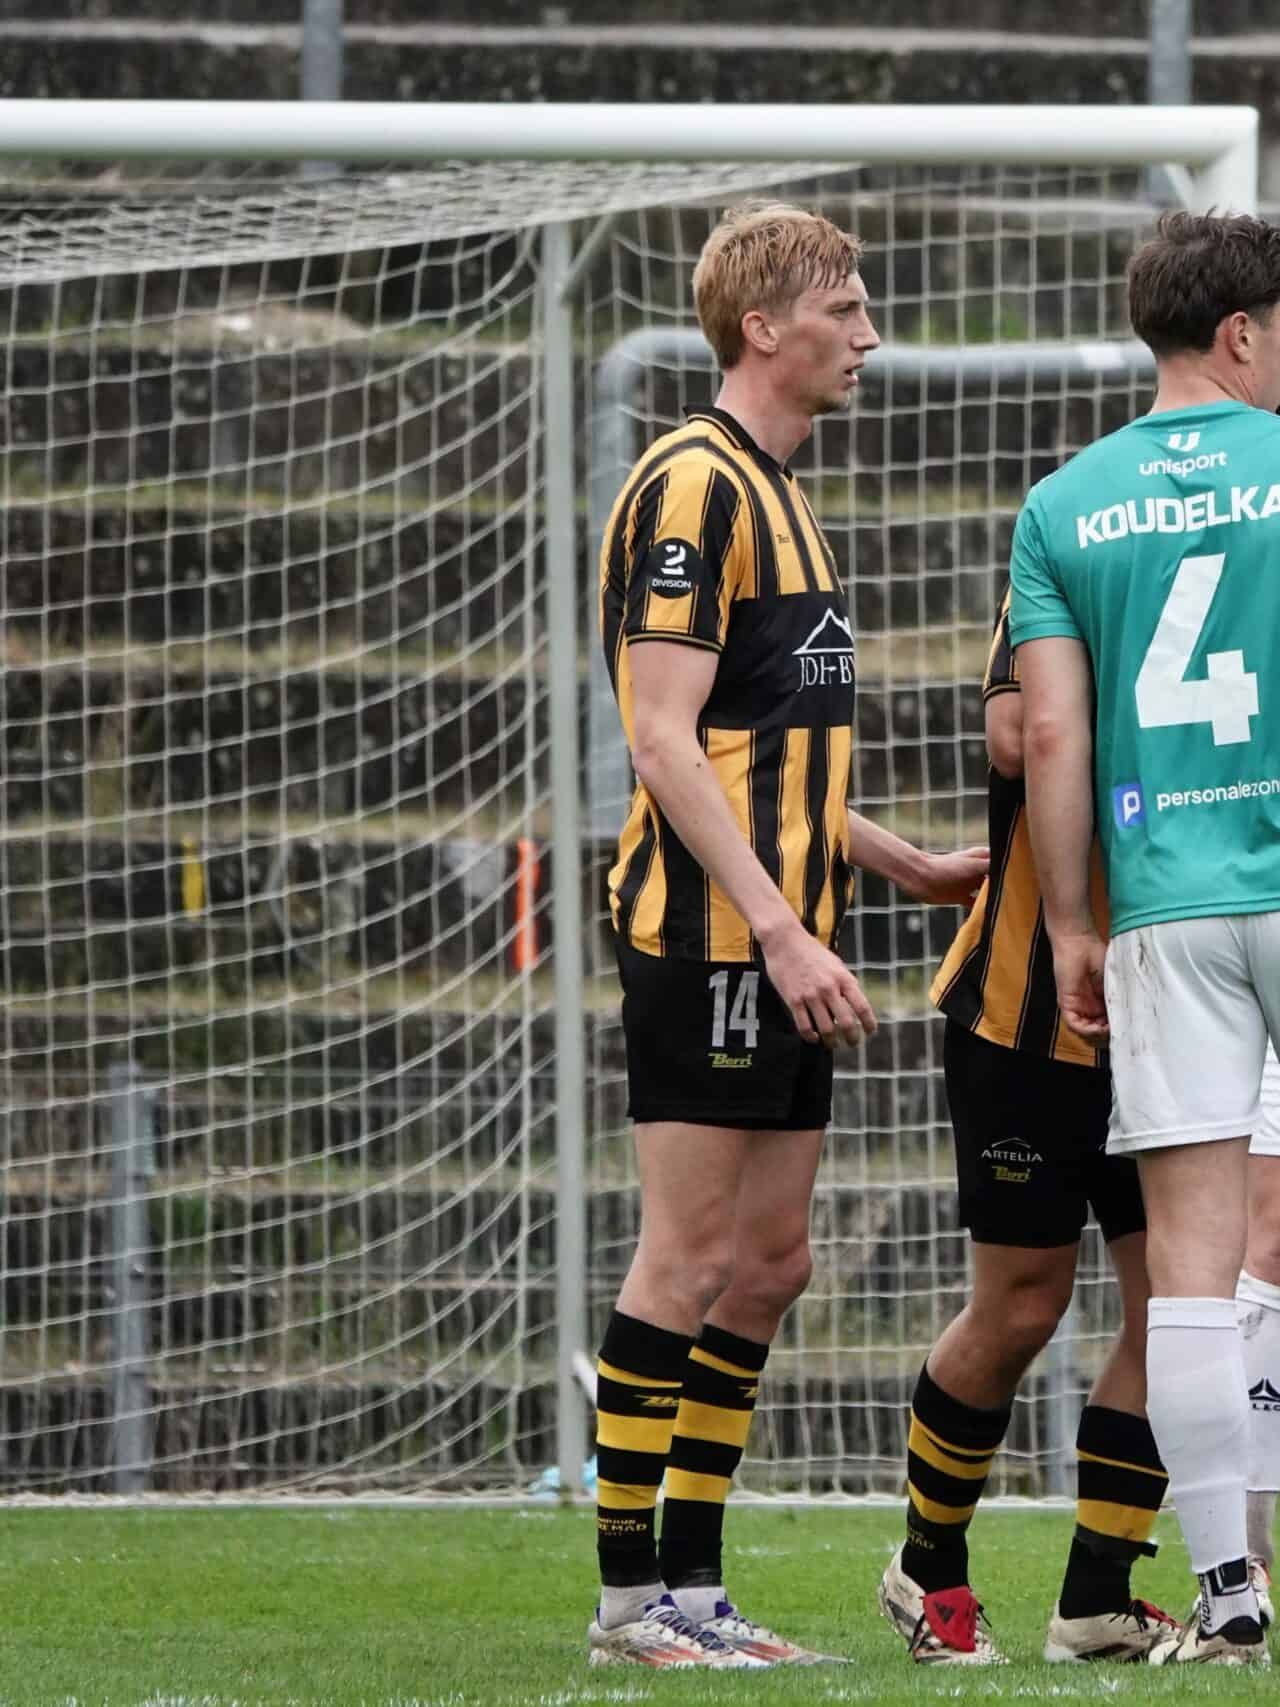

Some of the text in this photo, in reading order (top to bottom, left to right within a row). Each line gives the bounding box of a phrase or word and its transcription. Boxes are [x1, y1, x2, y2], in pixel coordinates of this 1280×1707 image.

[1139, 451, 1227, 478] unisport
[660, 544, 687, 576] 2
[652, 577, 692, 590] DIVISION
[1134, 552, 1260, 747] 4
[708, 969, 760, 1049] 14
[981, 1148, 1043, 1163] ARTELIA
